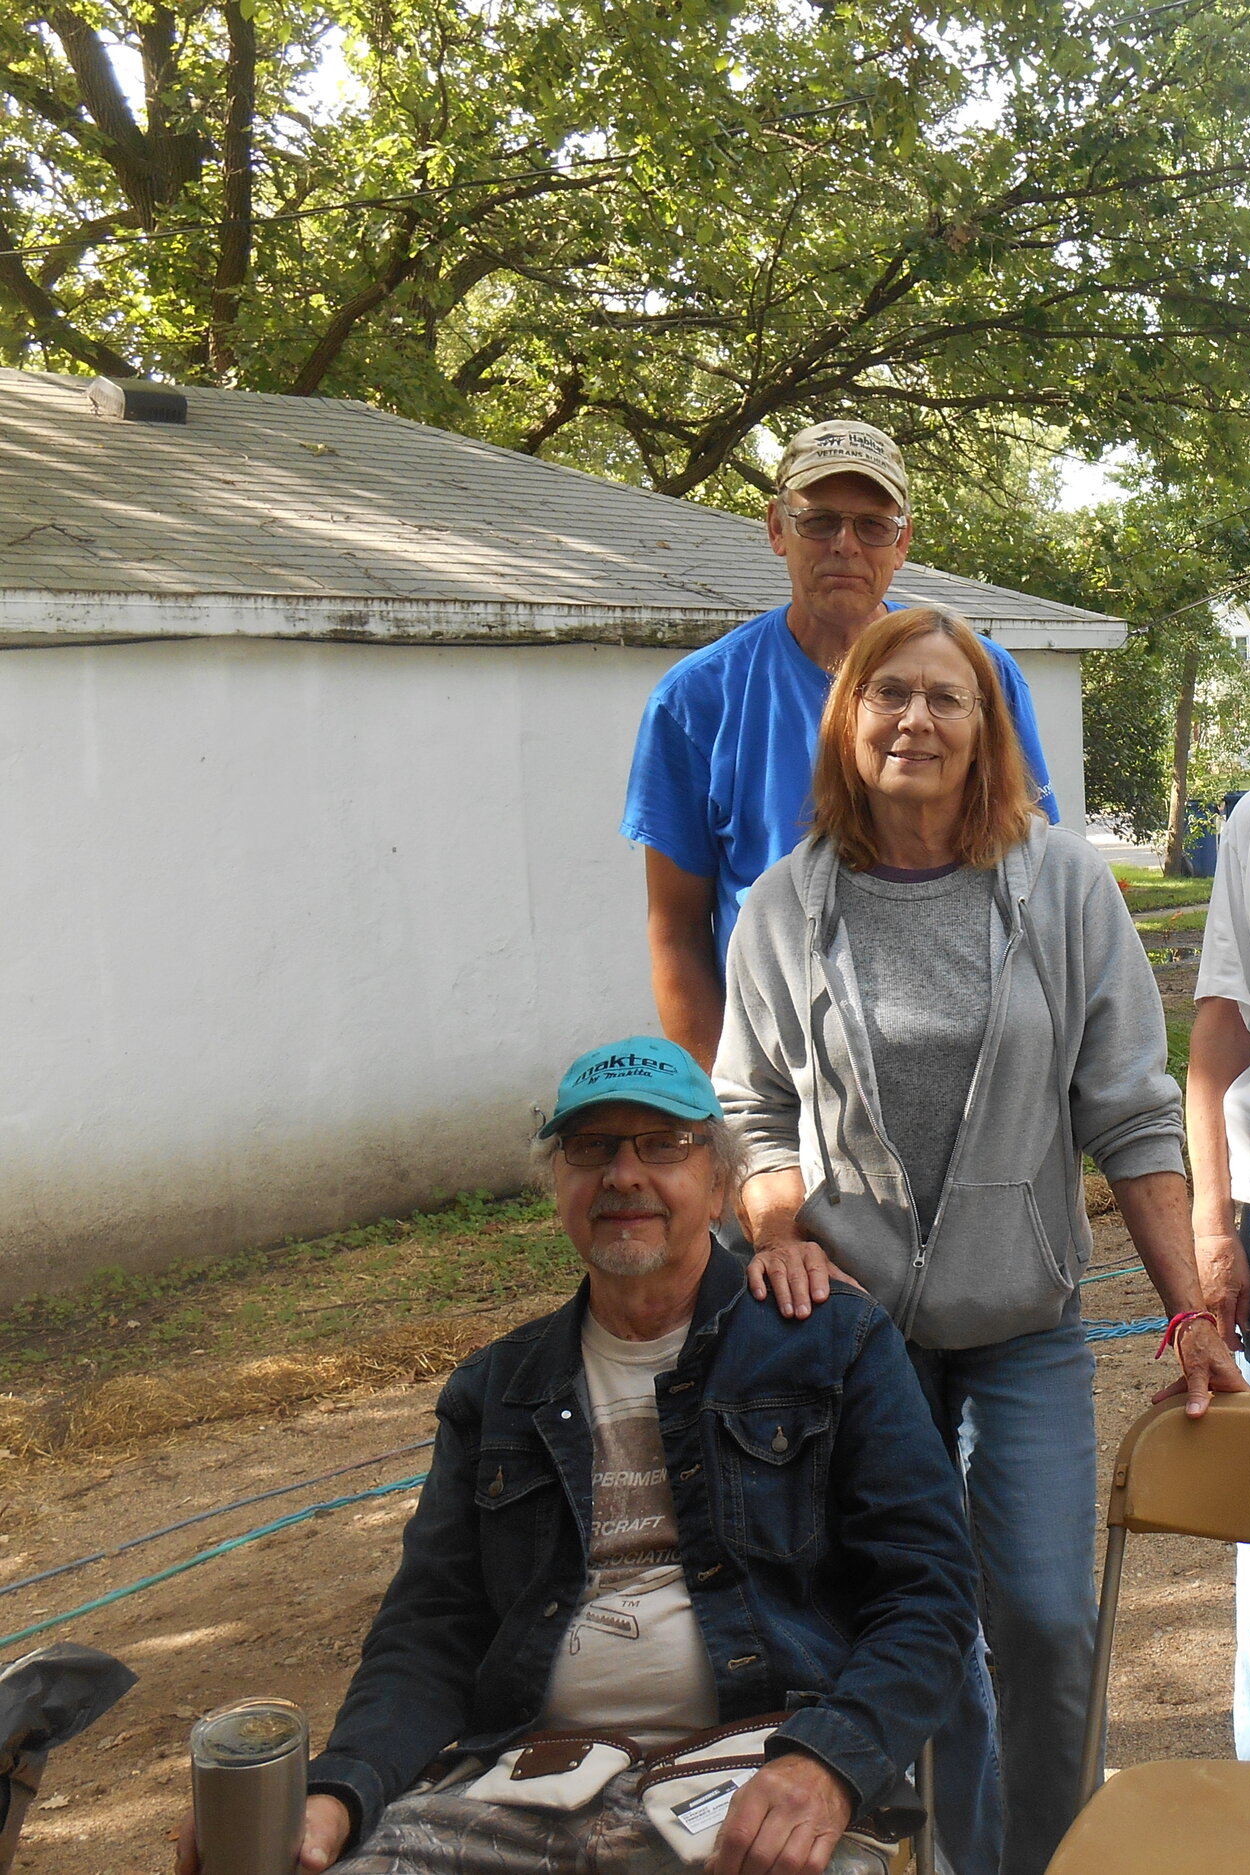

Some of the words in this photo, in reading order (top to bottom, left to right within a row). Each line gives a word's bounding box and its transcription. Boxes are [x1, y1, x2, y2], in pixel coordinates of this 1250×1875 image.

[848, 434, 885, 454] Habitat
[816, 449, 863, 458] VETERANS
[573, 1053, 678, 1086] maktec
[587, 1076, 600, 1085] by
[604, 1069, 653, 1080] Makita
[592, 1516, 665, 1535] RCRAFT
[621, 1600, 640, 1608] TM
